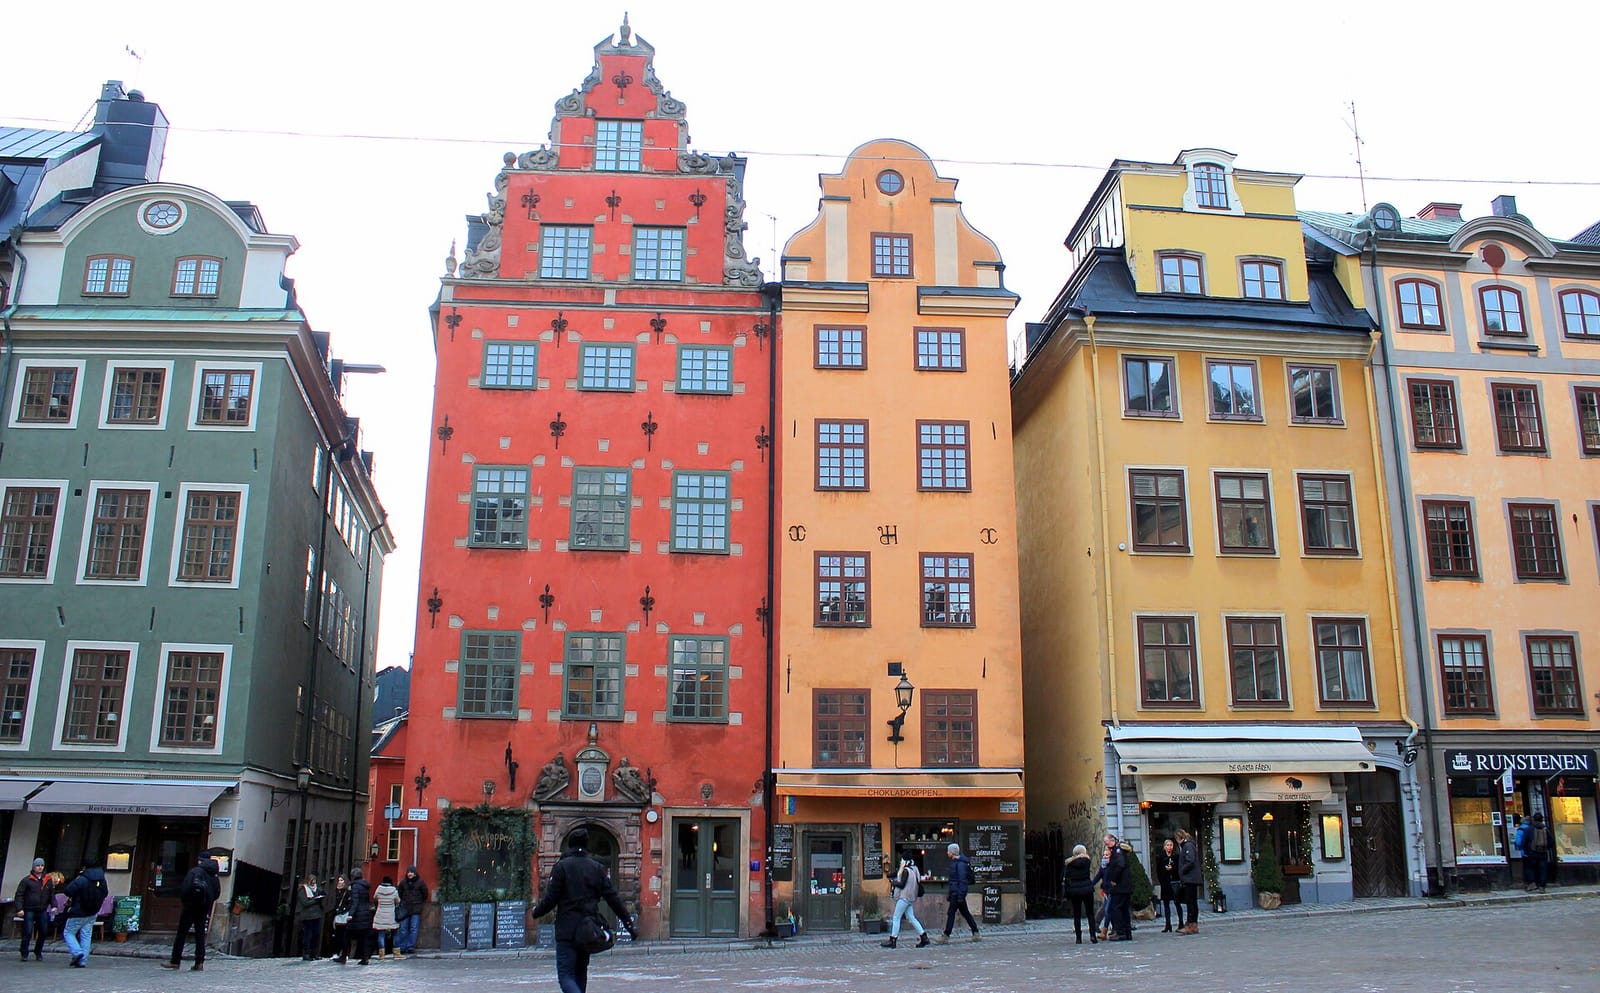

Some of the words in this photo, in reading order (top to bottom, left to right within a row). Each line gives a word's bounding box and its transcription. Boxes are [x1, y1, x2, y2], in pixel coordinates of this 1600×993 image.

[1475, 754, 1589, 770] RUNSTENEN
[1228, 764, 1237, 772] DE
[867, 789, 939, 797] CHOKLADKOPPEN
[88, 805, 126, 813] Restaurang
